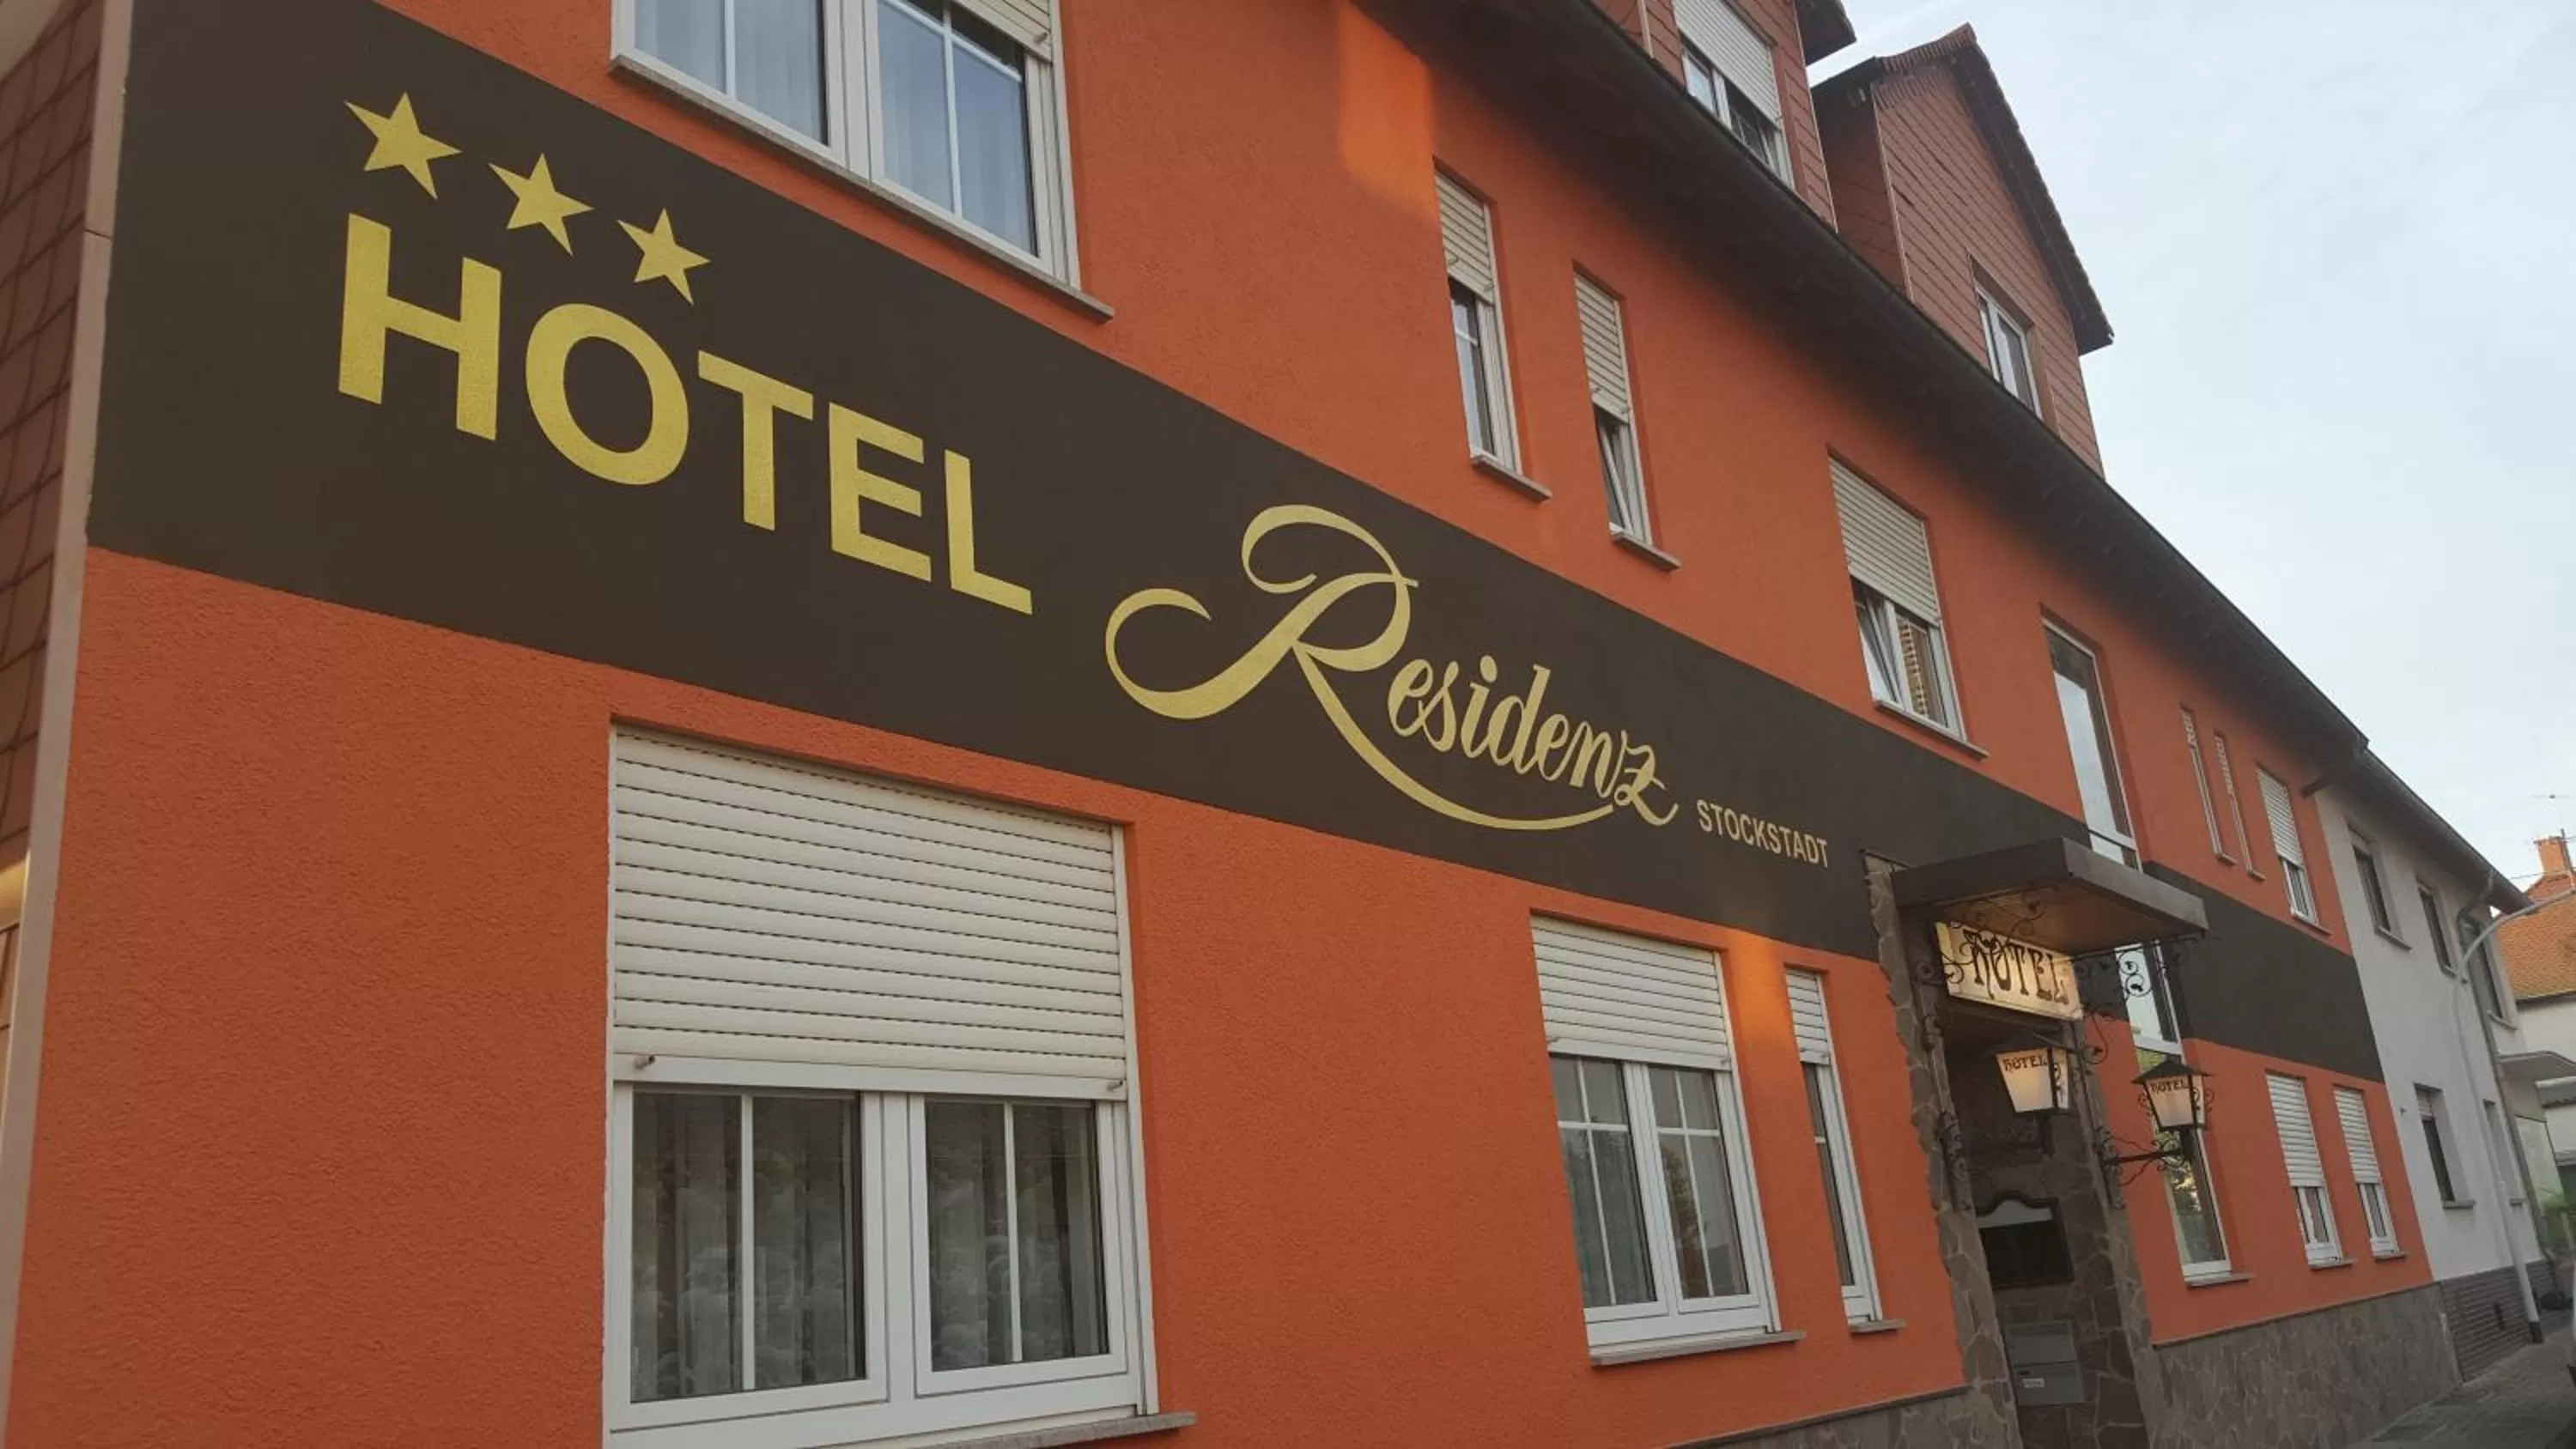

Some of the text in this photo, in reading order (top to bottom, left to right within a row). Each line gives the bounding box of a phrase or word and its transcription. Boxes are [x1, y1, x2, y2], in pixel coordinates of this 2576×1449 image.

[338, 212, 1828, 869] HOTEL Residenz STOCKSTADT
